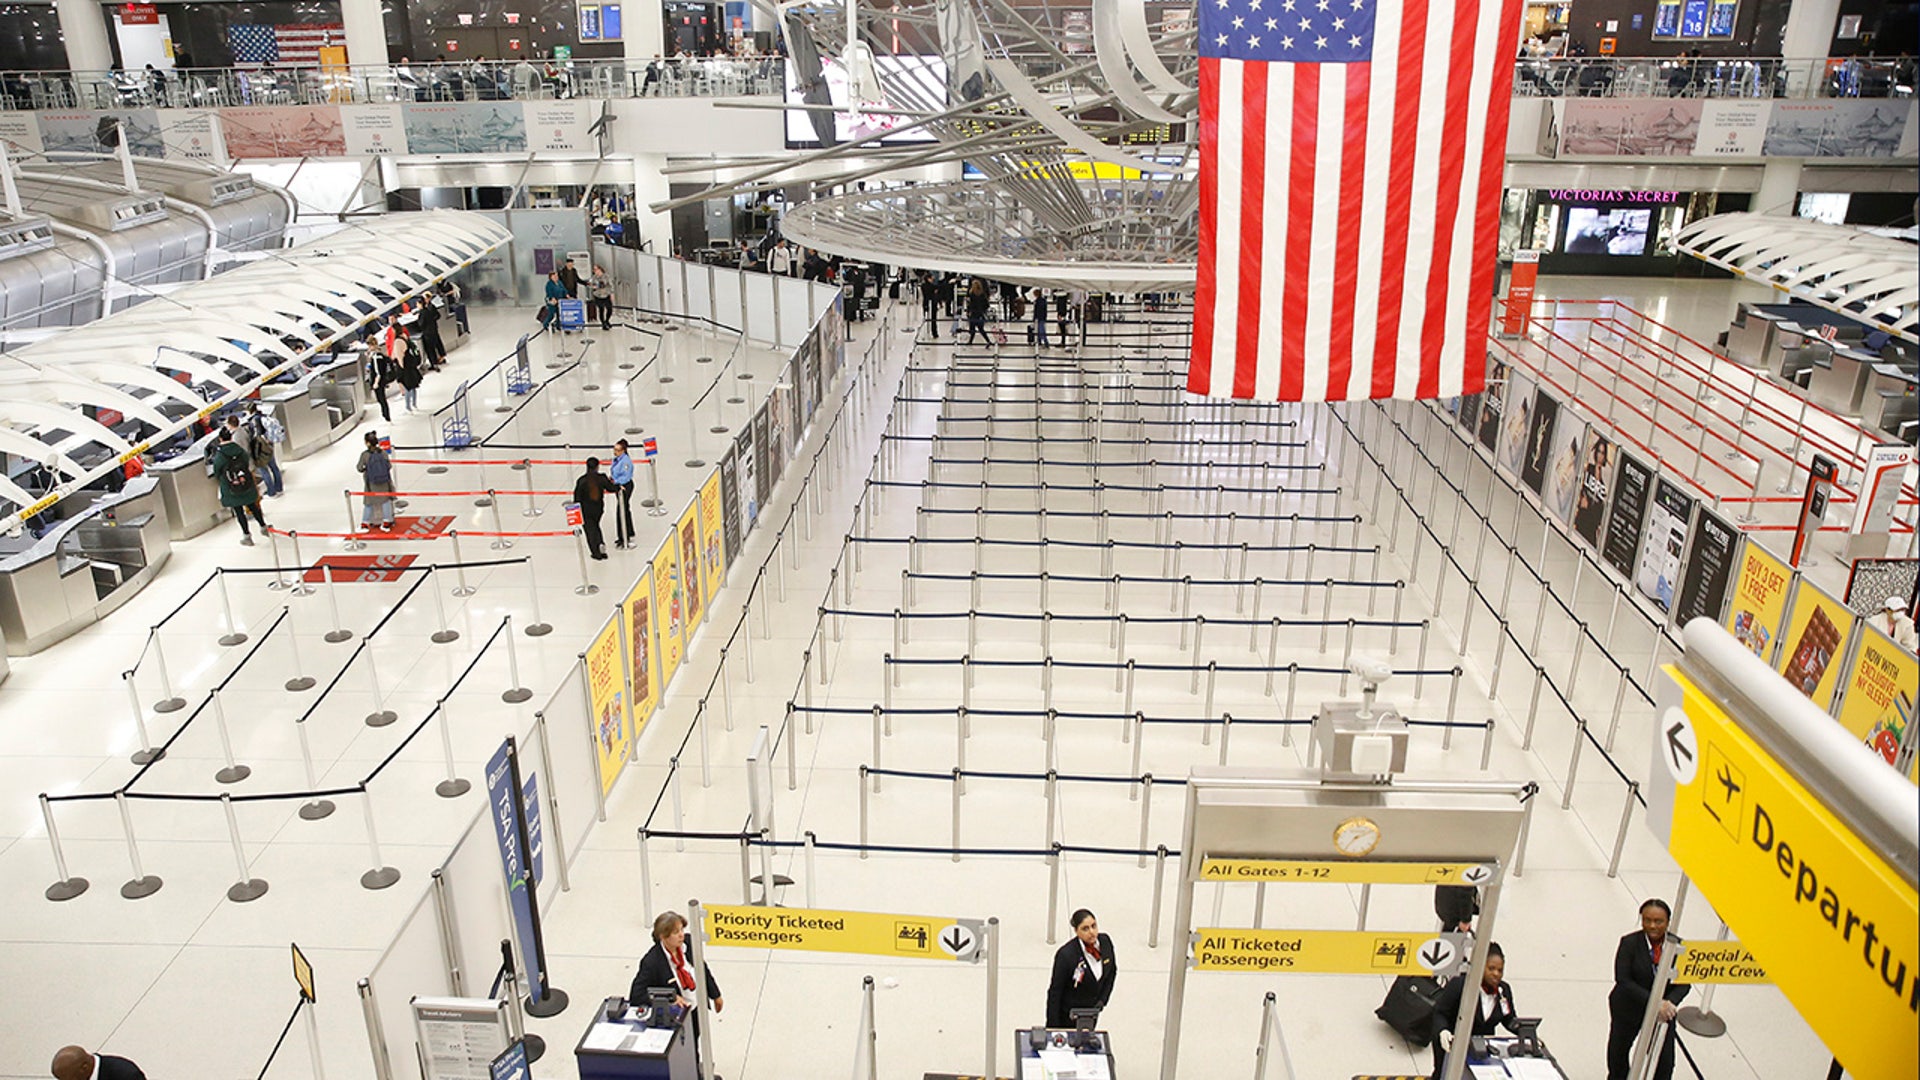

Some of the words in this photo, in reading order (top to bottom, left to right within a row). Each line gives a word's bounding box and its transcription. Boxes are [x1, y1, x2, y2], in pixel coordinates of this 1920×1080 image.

[1549, 189, 1624, 201] VICTORIA'S
[1628, 191, 1679, 202] SECRET
[1747, 555, 1763, 577] BUY
[1762, 566, 1769, 584] 3
[1768, 571, 1785, 595] GET
[1748, 577, 1768, 605] FREE
[1865, 645, 1882, 667] NOW
[1881, 656, 1900, 681] WITH
[1860, 660, 1897, 697] EXCLUSIVE
[1856, 675, 1867, 691] NY
[1866, 682, 1893, 711] SLEEVE
[498, 787, 513, 838] TSA
[504, 834, 517, 876] Pre
[1207, 865, 1233, 876] All
[1238, 866, 1288, 877] Gates
[1294, 867, 1331, 879] 1-12
[713, 911, 773, 929] Priority
[776, 914, 845, 931] Ticketed
[714, 926, 803, 945] Passengers
[1202, 936, 1226, 950] All
[1230, 938, 1302, 952] Ticketed
[1201, 952, 1295, 970] Passengers
[1687, 949, 1741, 965] Special
[1683, 964, 1726, 980] Flight
[1728, 965, 1767, 978] Crew
[422, 1009, 438, 1017] Travel
[439, 1010, 463, 1018] Advisory
